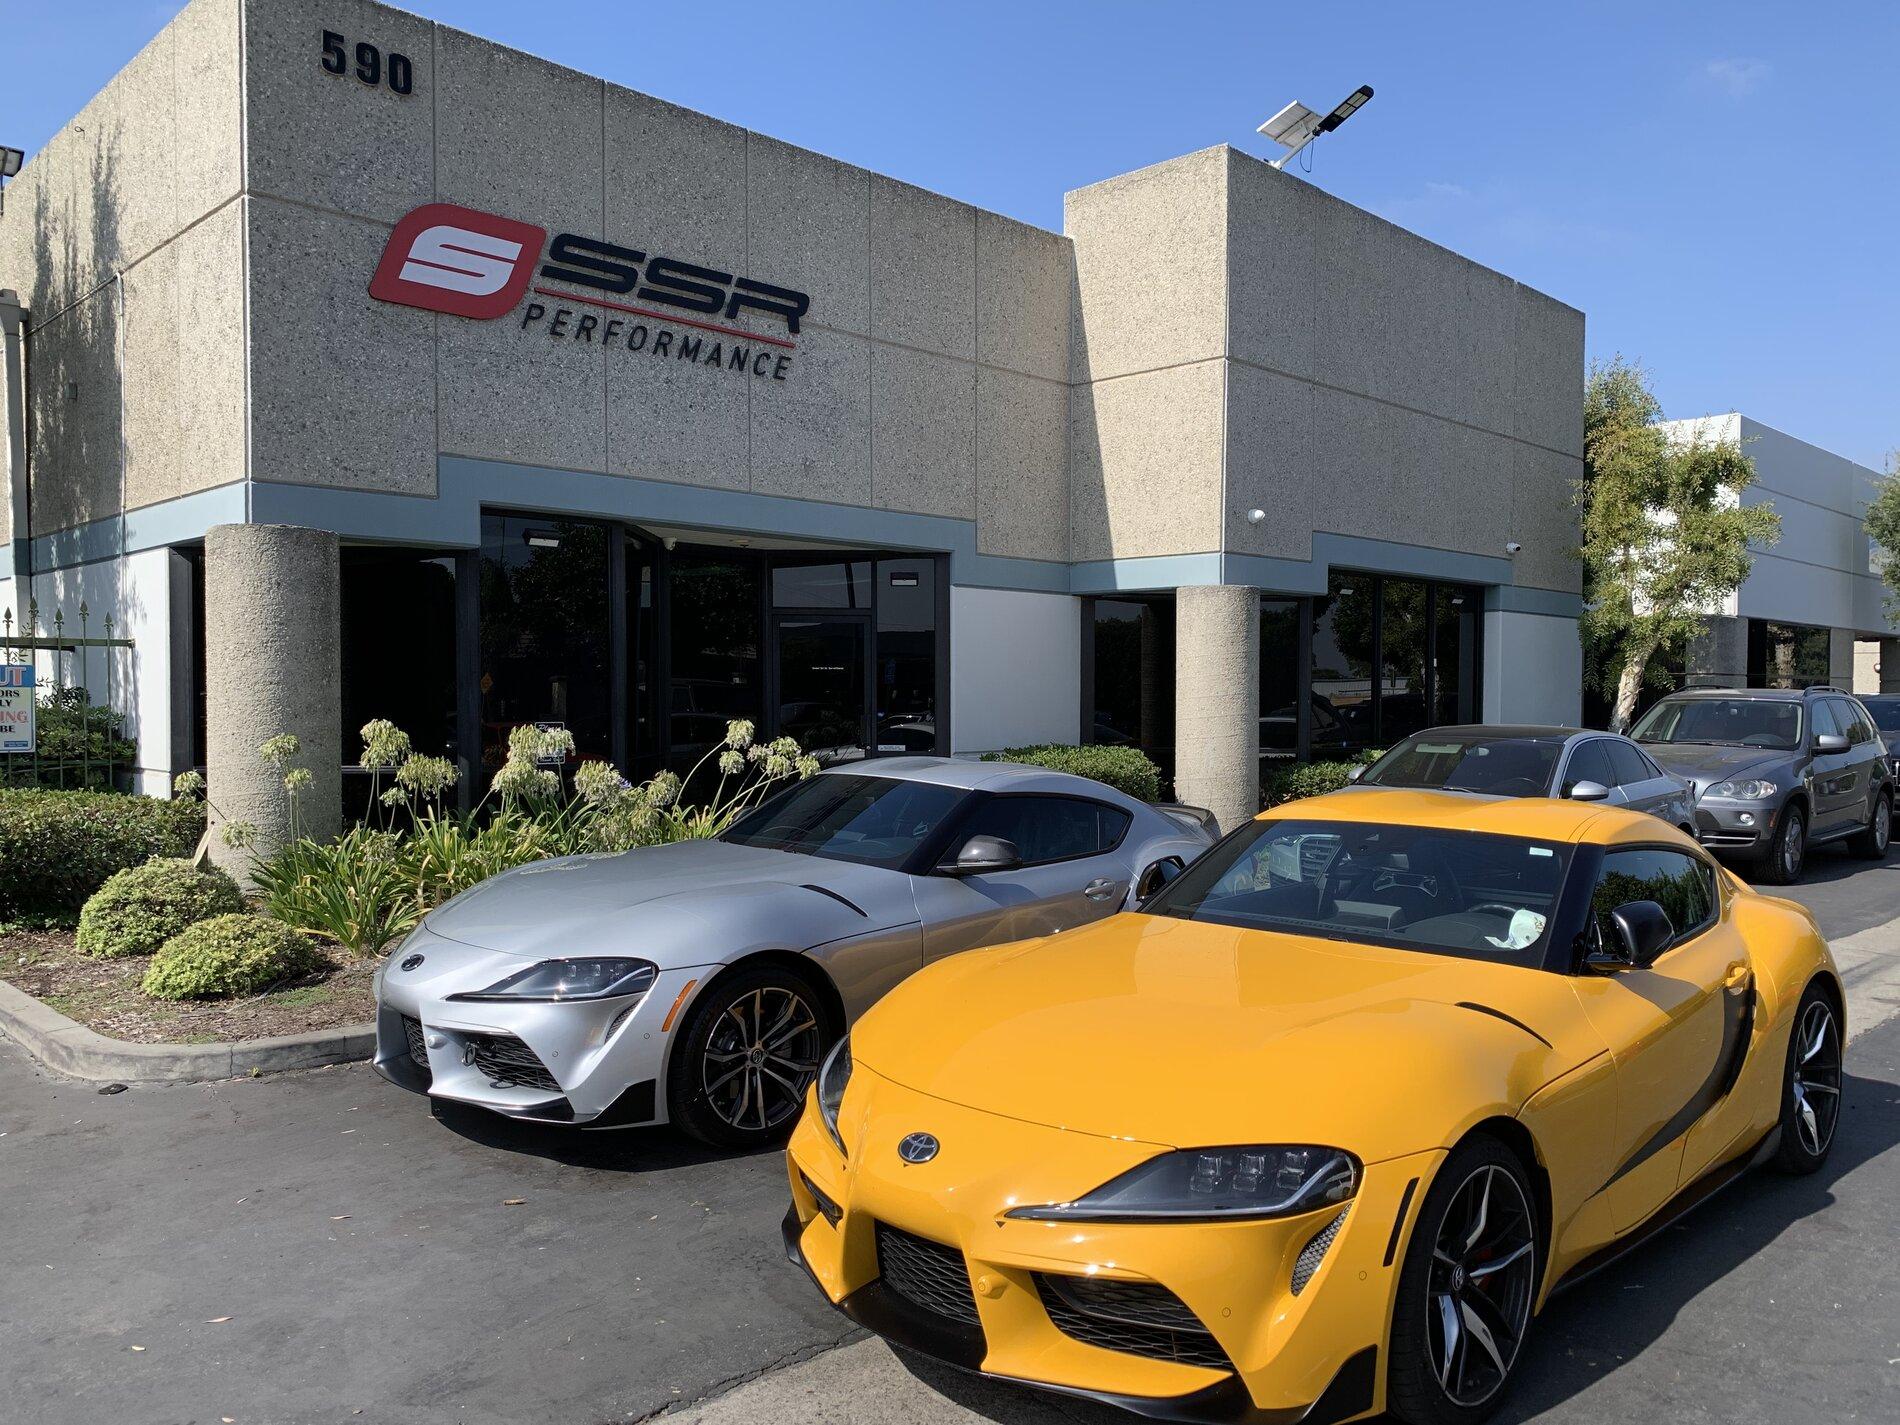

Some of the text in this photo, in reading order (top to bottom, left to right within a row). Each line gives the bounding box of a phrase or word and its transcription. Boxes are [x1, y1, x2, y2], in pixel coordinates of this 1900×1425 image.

[321, 29, 413, 95] 590
[540, 233, 810, 334] SSR
[521, 303, 793, 381] PERFORMANCE
[0, 725, 15, 733] BE
